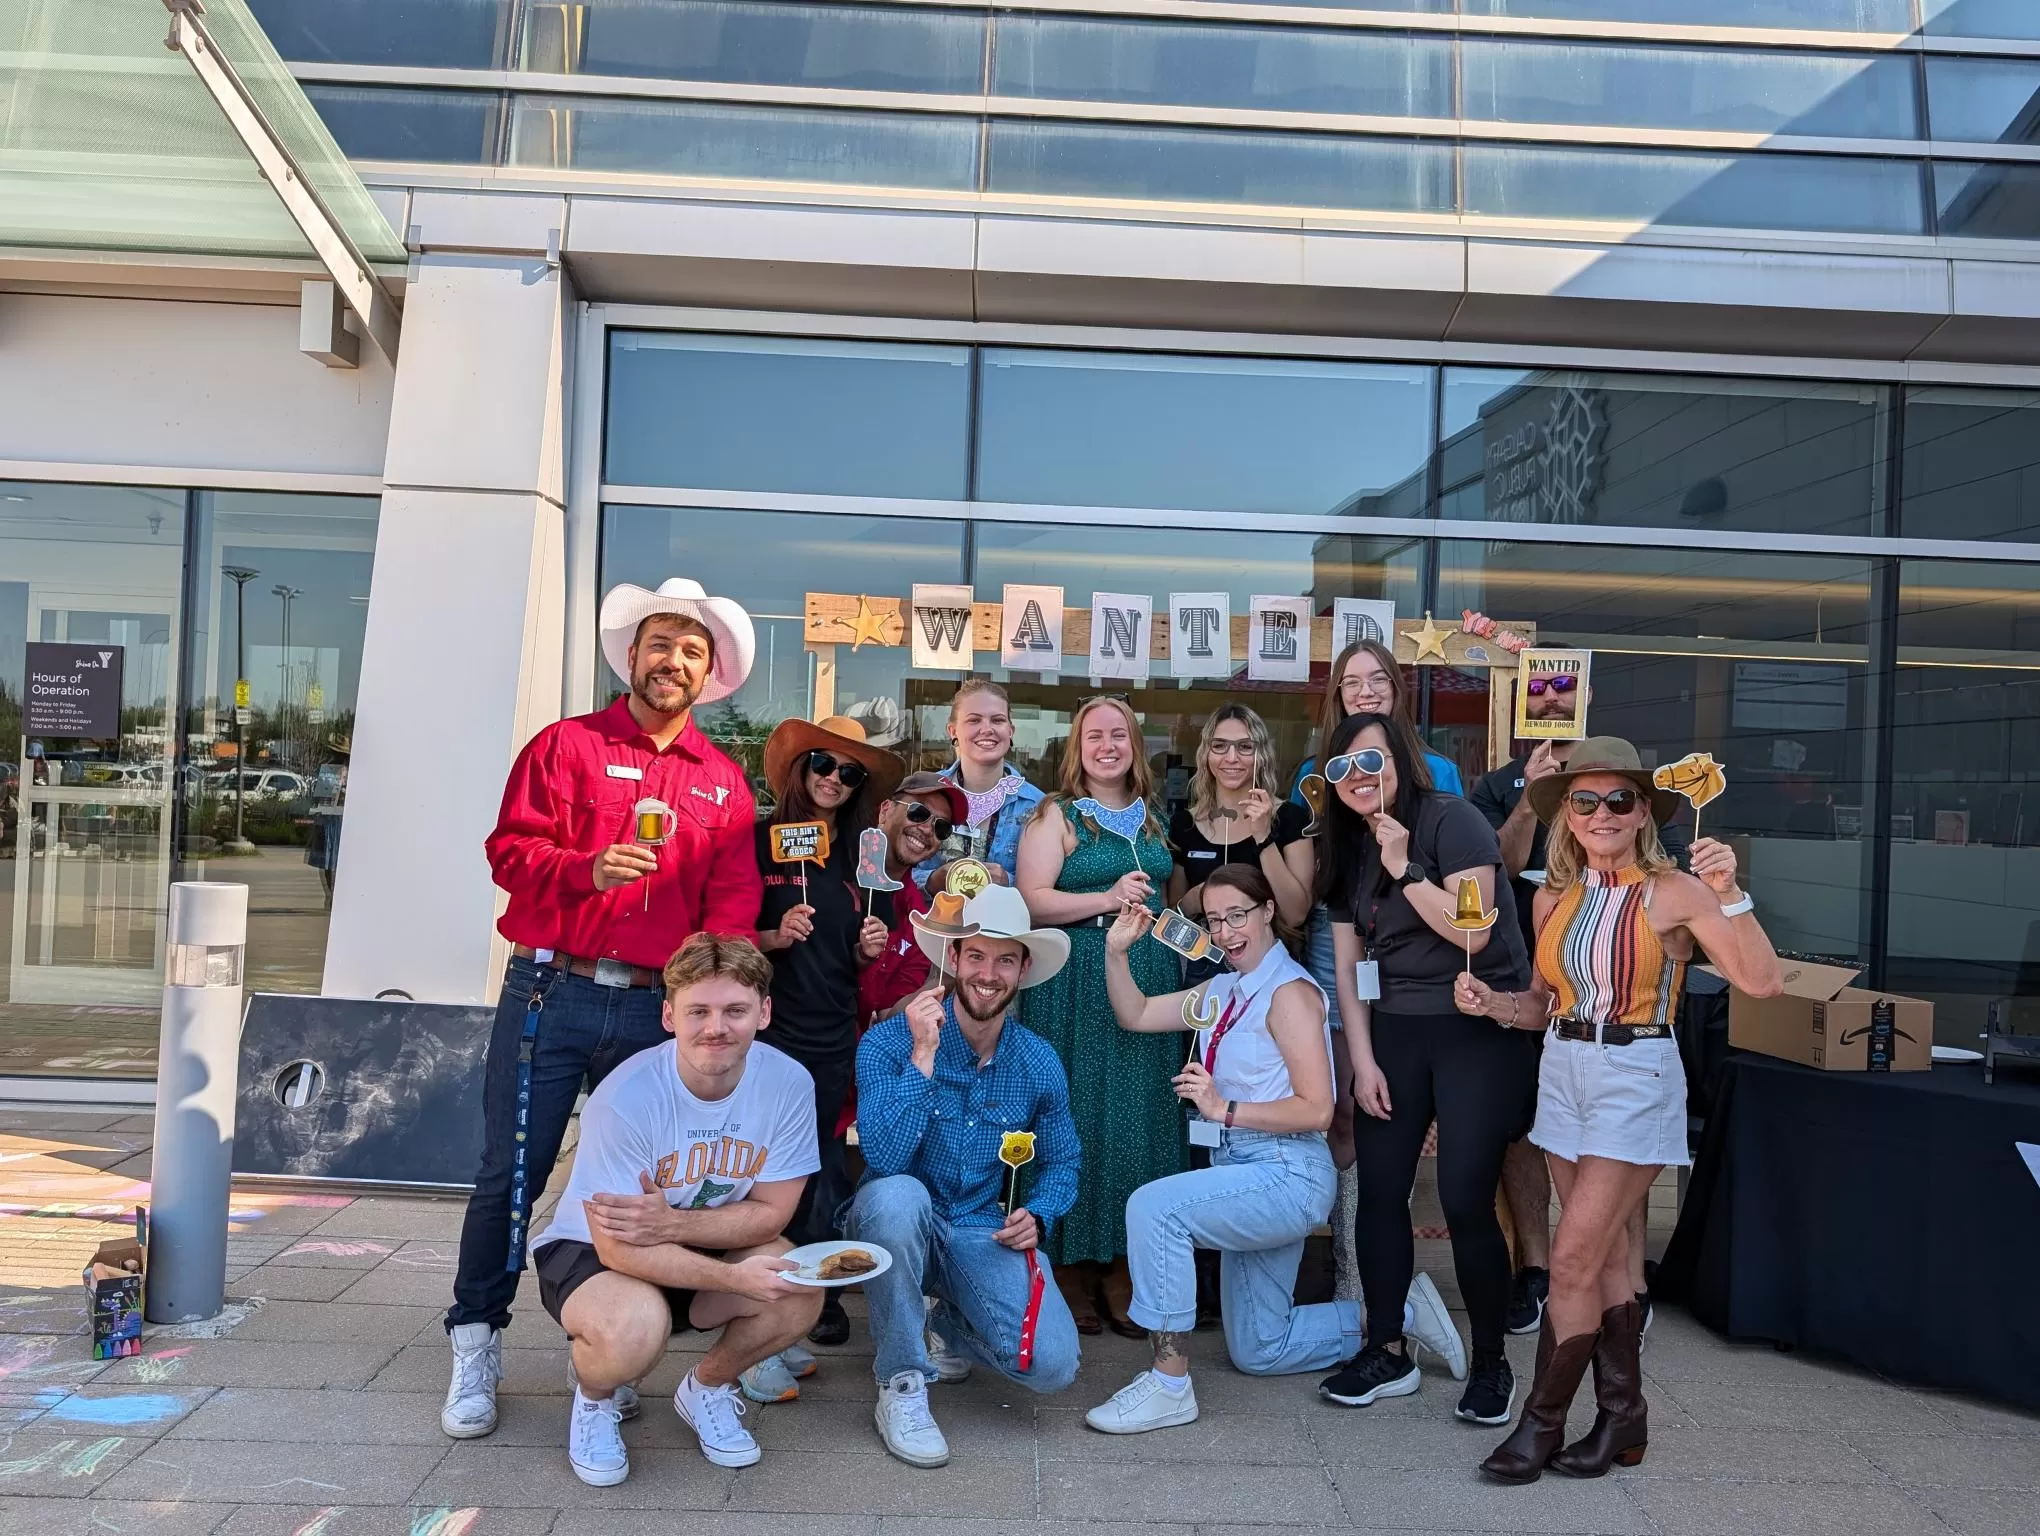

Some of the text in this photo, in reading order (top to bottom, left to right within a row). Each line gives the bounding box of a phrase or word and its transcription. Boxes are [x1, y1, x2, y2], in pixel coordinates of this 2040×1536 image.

[1528, 660, 1580, 672] WANTED
[32, 672, 82, 683] Hours of
[31, 684, 90, 696] Operation
[1525, 720, 1552, 728] REWARD
[780, 827, 818, 837] THIS AIN'T
[782, 837, 818, 847] MY FIRST
[789, 847, 814, 857] RODEO
[730, 1123, 741, 1132] OF
